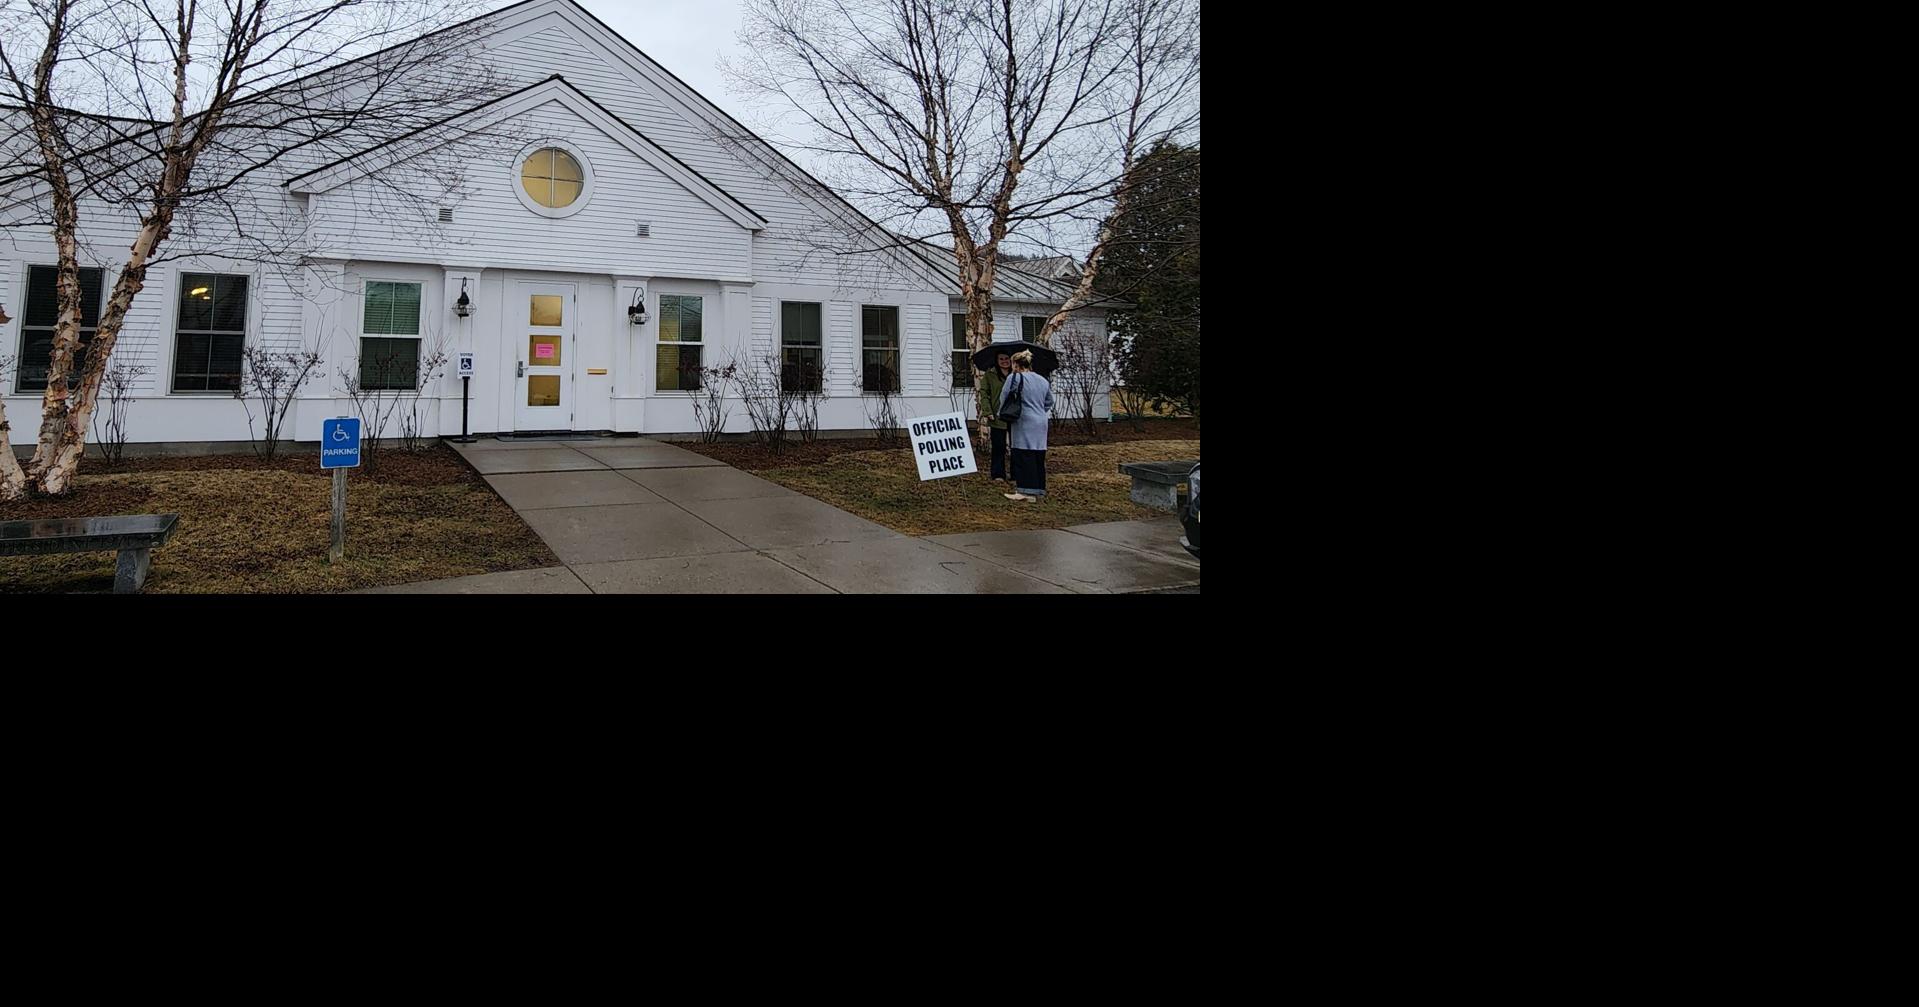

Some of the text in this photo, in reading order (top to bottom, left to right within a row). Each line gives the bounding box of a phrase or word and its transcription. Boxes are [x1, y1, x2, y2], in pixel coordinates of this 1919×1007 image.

[912, 417, 963, 437] OFFICIAL
[323, 447, 358, 456] PARKING
[918, 436, 965, 456] POLLING
[929, 455, 965, 474] PLACE
